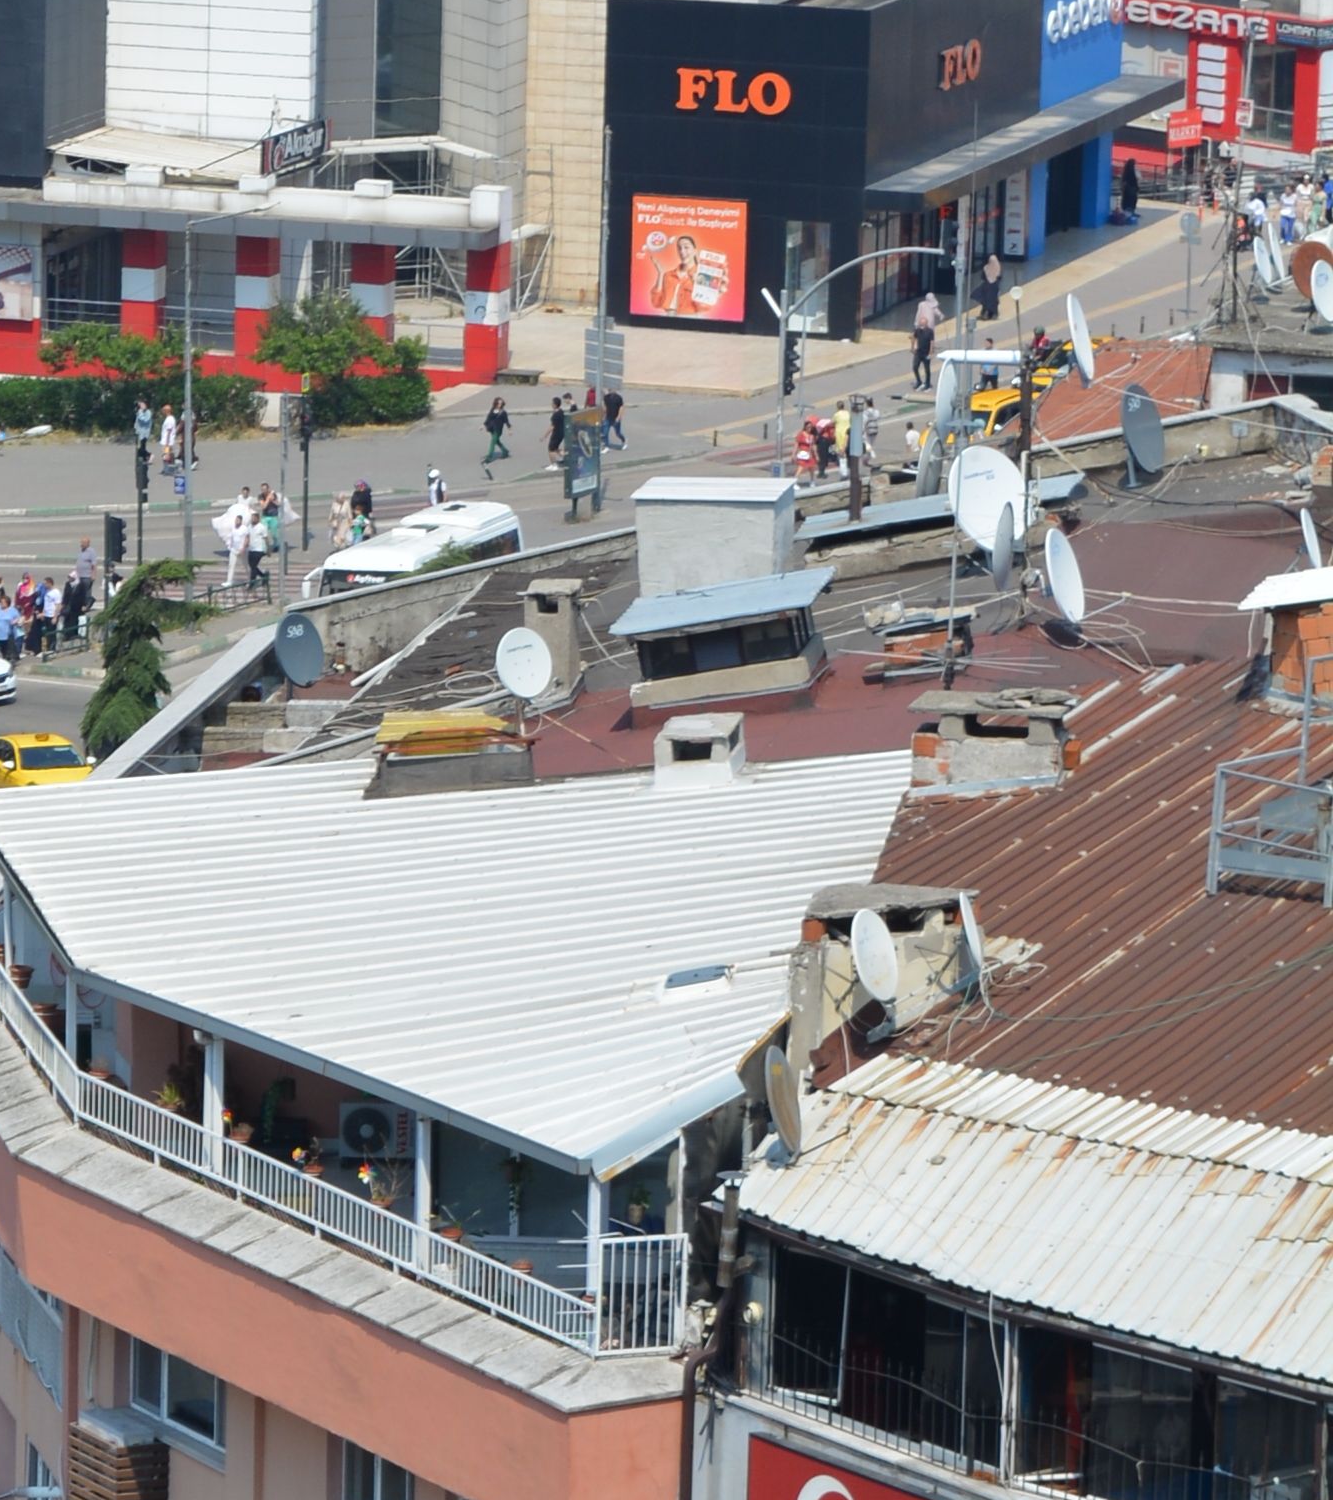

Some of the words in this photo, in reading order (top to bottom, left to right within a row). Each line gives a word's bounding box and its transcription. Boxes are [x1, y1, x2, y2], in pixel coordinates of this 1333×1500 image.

[940, 38, 981, 90] FLO
[675, 67, 791, 116] FLO
[637, 202, 656, 213] Yeni
